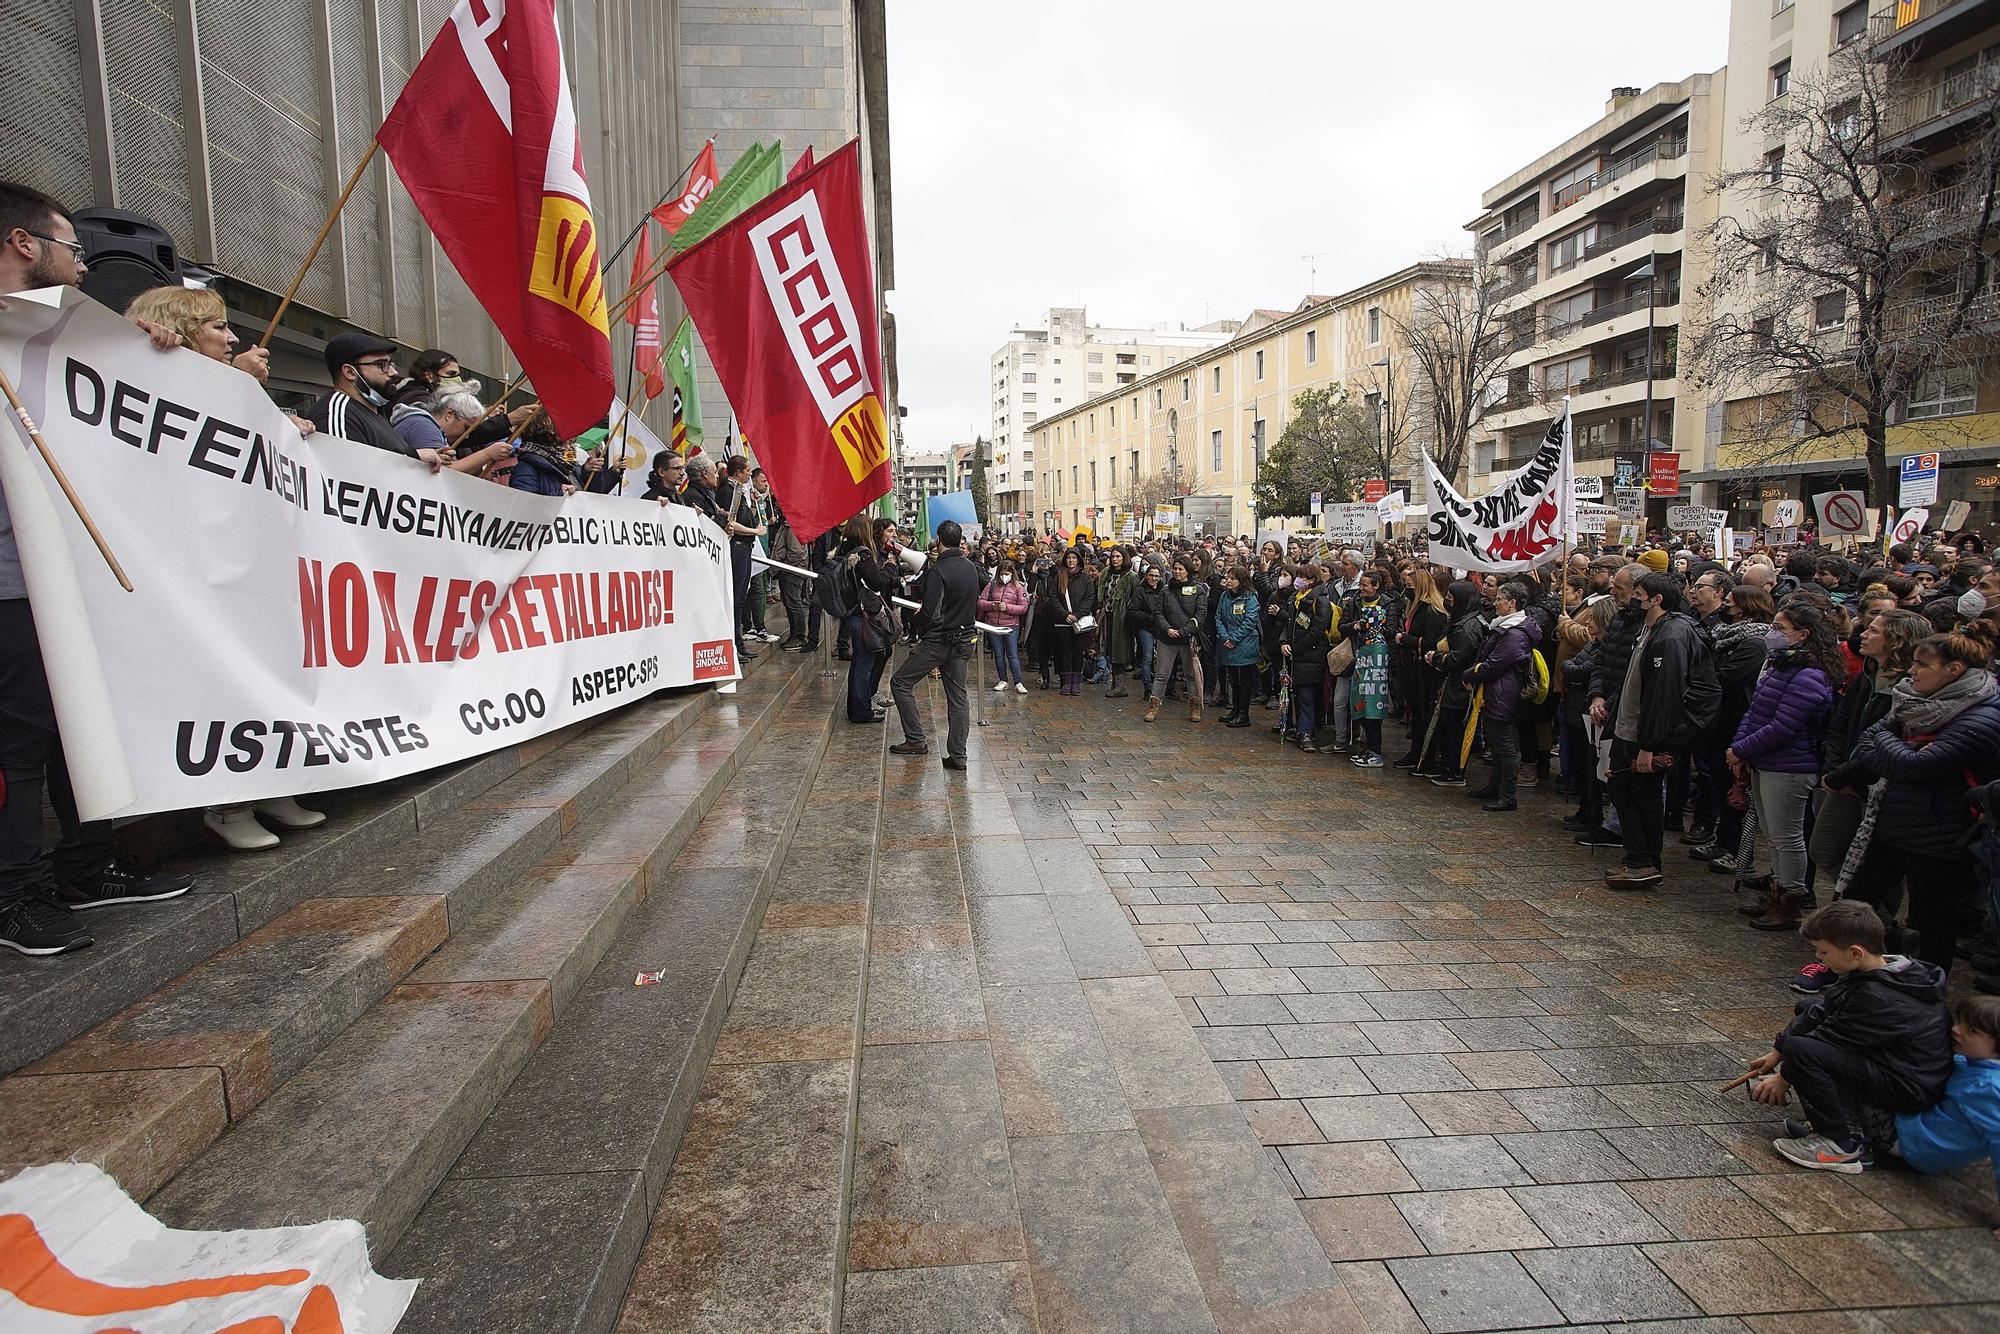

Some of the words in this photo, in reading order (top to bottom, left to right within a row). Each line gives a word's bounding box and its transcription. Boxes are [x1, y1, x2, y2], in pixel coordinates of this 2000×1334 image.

[767, 214, 862, 399] CCOO
[65, 356, 309, 511] DEFENSEM
[320, 472, 551, 552] L'ENSENYAMENT
[610, 520, 628, 545] LA
[634, 521, 666, 547] SEVA
[1905, 459, 1916, 470] P
[298, 556, 370, 668] NO
[373, 570, 411, 664] A
[412, 575, 496, 662] LES
[488, 569, 674, 654] RETALLADES!
[696, 649, 715, 660] INTER
[696, 656, 728, 668] SINDICAL
[459, 687, 546, 736] CC.OO
[571, 655, 659, 706] ASPEPC-SPS
[1358, 683, 1376, 695] EN
